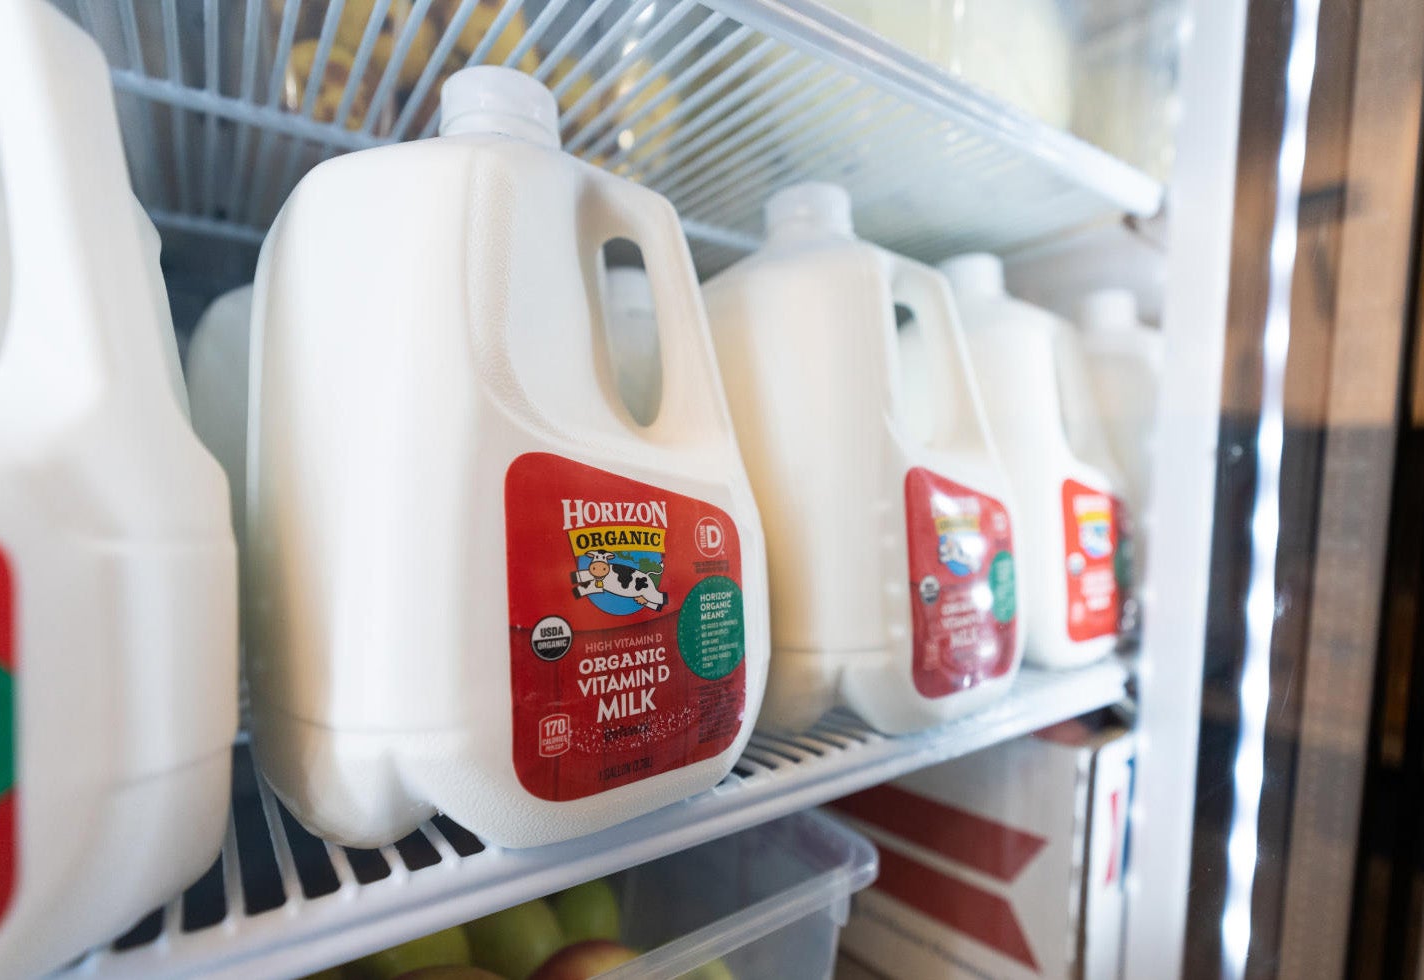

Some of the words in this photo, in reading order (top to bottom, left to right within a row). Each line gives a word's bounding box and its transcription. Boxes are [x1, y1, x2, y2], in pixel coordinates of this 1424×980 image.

[561, 499, 668, 530] HORIZON
[576, 531, 661, 549] ORGANIC
[706, 525, 722, 549] D
[700, 591, 732, 602] HORIZON
[700, 600, 732, 611] ORGANIC
[540, 626, 564, 638] USDA
[537, 639, 567, 650] ORGANIC
[585, 641, 612, 654] HIGH
[614, 635, 654, 649] VITAMIN
[656, 633, 663, 643] D
[578, 647, 666, 675] ORGANIC
[577, 666, 654, 697] VITAMIN
[657, 664, 670, 683] D
[596, 687, 657, 723] MILK
[544, 719, 565, 737] 170
